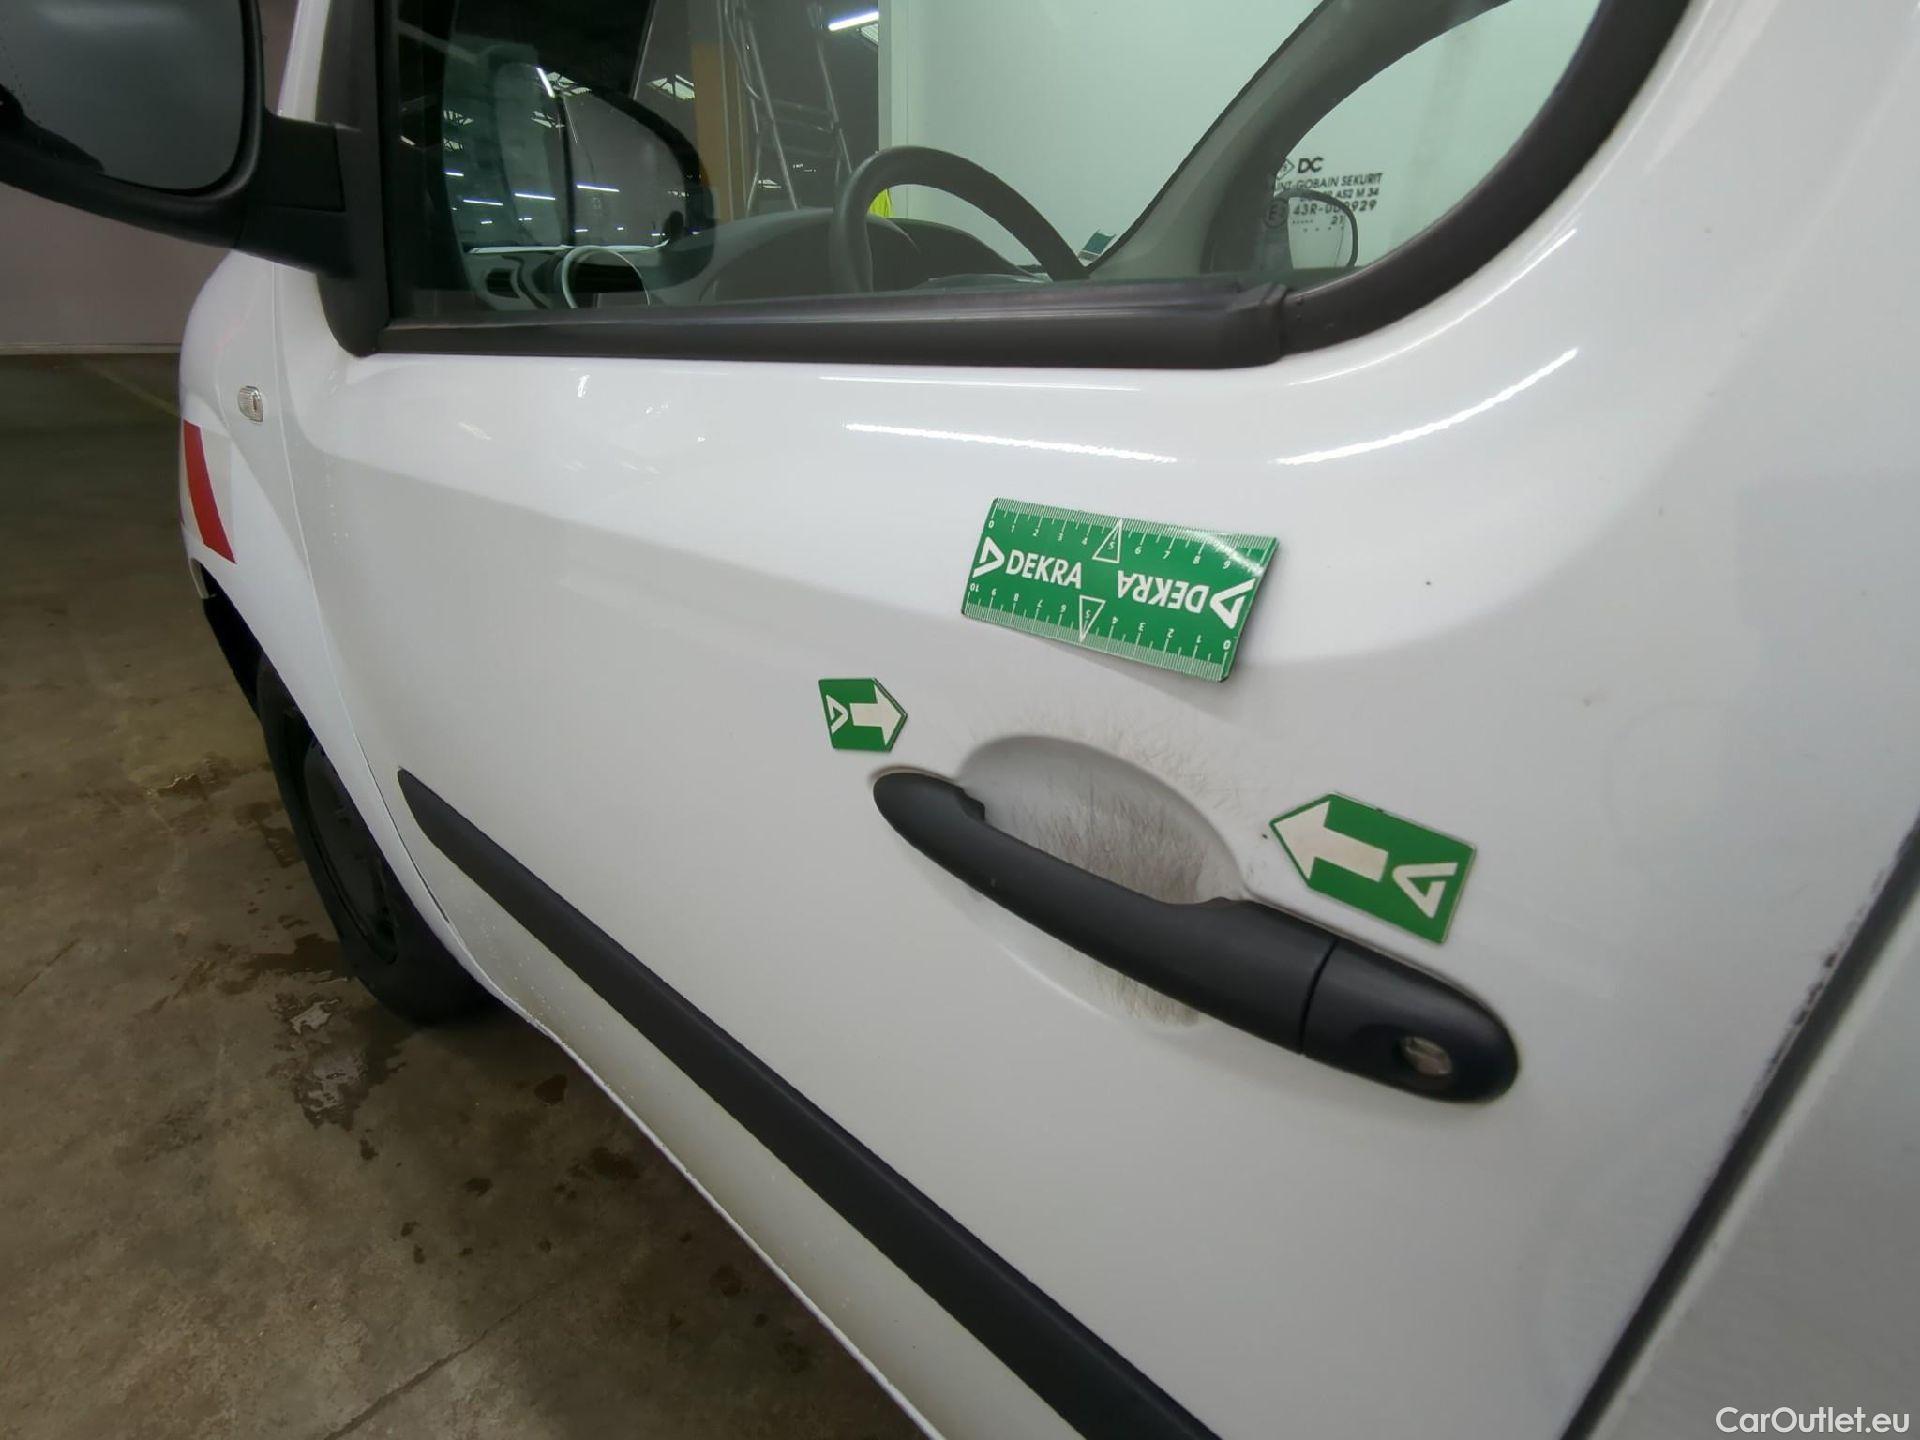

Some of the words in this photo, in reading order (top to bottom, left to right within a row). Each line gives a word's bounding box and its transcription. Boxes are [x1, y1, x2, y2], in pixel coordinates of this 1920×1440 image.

[1297, 157, 1324, 173] DC
[1341, 172, 1384, 187] SEKURIT
[988, 520, 995, 529] 0
[1011, 524, 1016, 533] 1
[1032, 529, 1040, 537] 2
[1058, 532, 1064, 542] 3
[1081, 537, 1088, 546] 4
[1108, 542, 1115, 550] 5
[1134, 546, 1142, 555] 6
[1162, 550, 1171, 560] 7
[1192, 555, 1201, 565] 8
[1222, 560, 1231, 569] 9
[1005, 549, 1082, 590] DEKRA
[969, 582, 980, 593] 10
[991, 588, 997, 597] 9
[1117, 569, 1210, 614] DEKRA
[1013, 592, 1019, 602] 8
[1037, 599, 1044, 609] 7
[1060, 604, 1067, 614] 6
[1112, 616, 1119, 625] 4
[1138, 622, 1146, 632] 3
[1167, 628, 1175, 639] 2
[1222, 639, 1231, 650] 0
